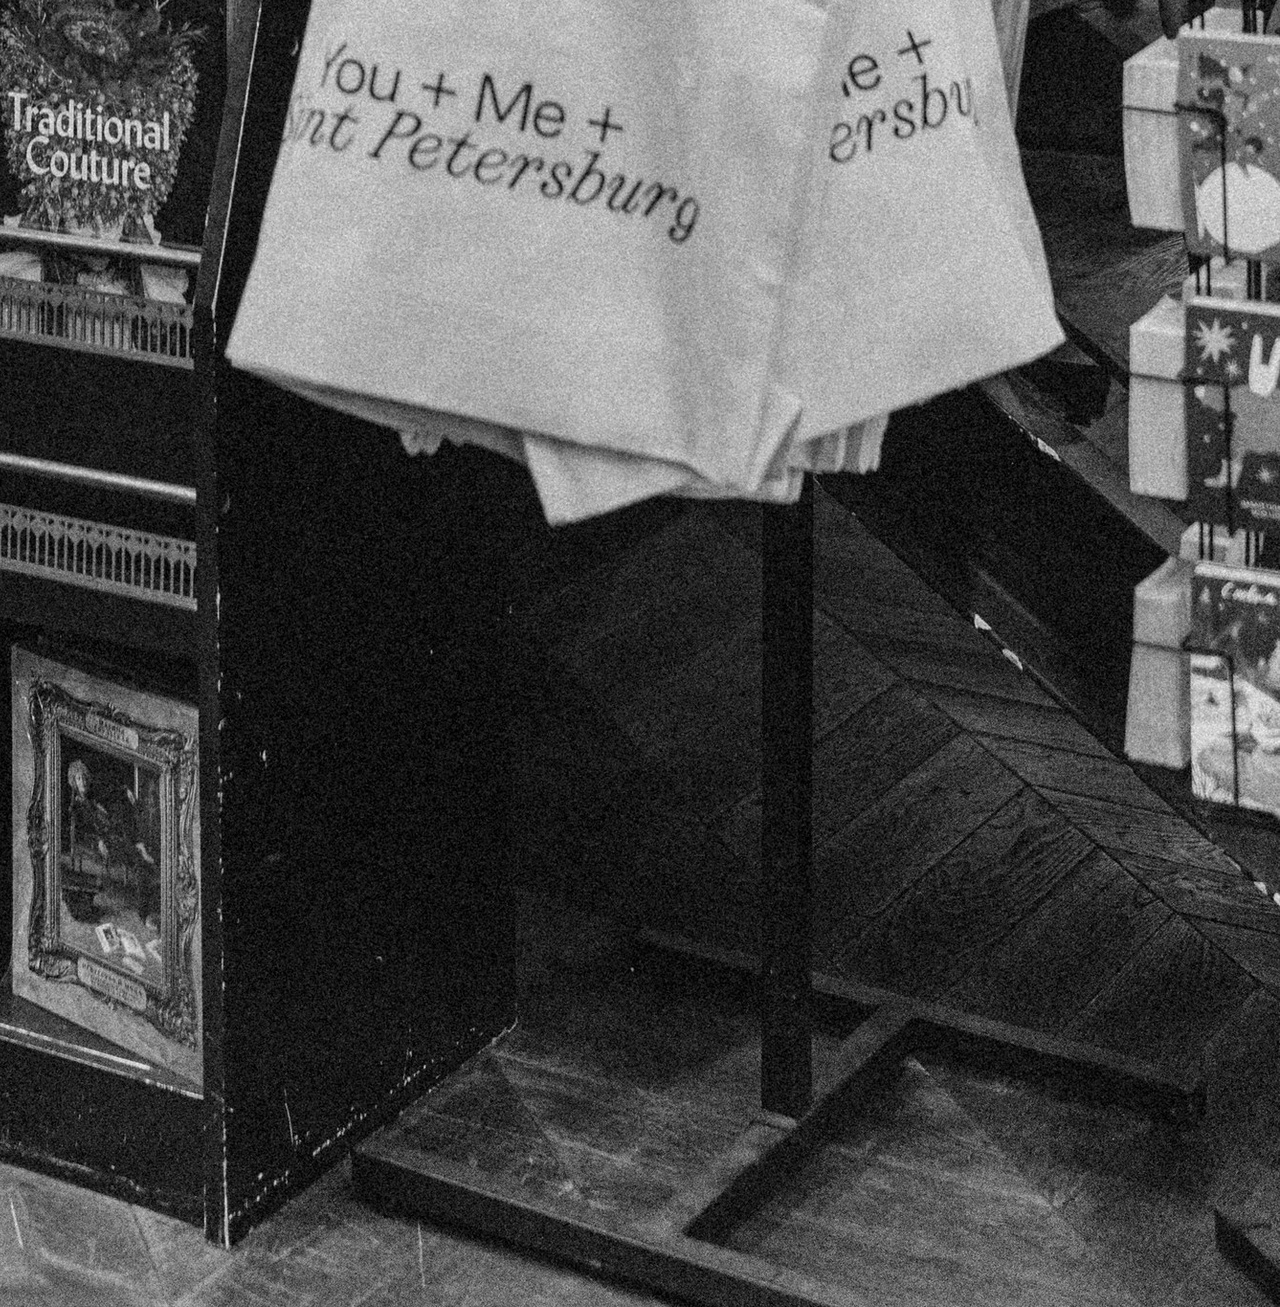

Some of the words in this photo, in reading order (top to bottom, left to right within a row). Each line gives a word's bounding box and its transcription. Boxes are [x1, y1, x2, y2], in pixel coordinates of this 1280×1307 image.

[842, 54, 882, 97] e
[897, 29, 932, 65] +
[8, 92, 170, 151] Traditional
[422, 71, 456, 108] +
[475, 73, 566, 138] Me
[588, 107, 624, 144] +
[830, 72, 979, 163] ersbu
[26, 135, 151, 190] Couture
[368, 110, 700, 244] Petersburg
